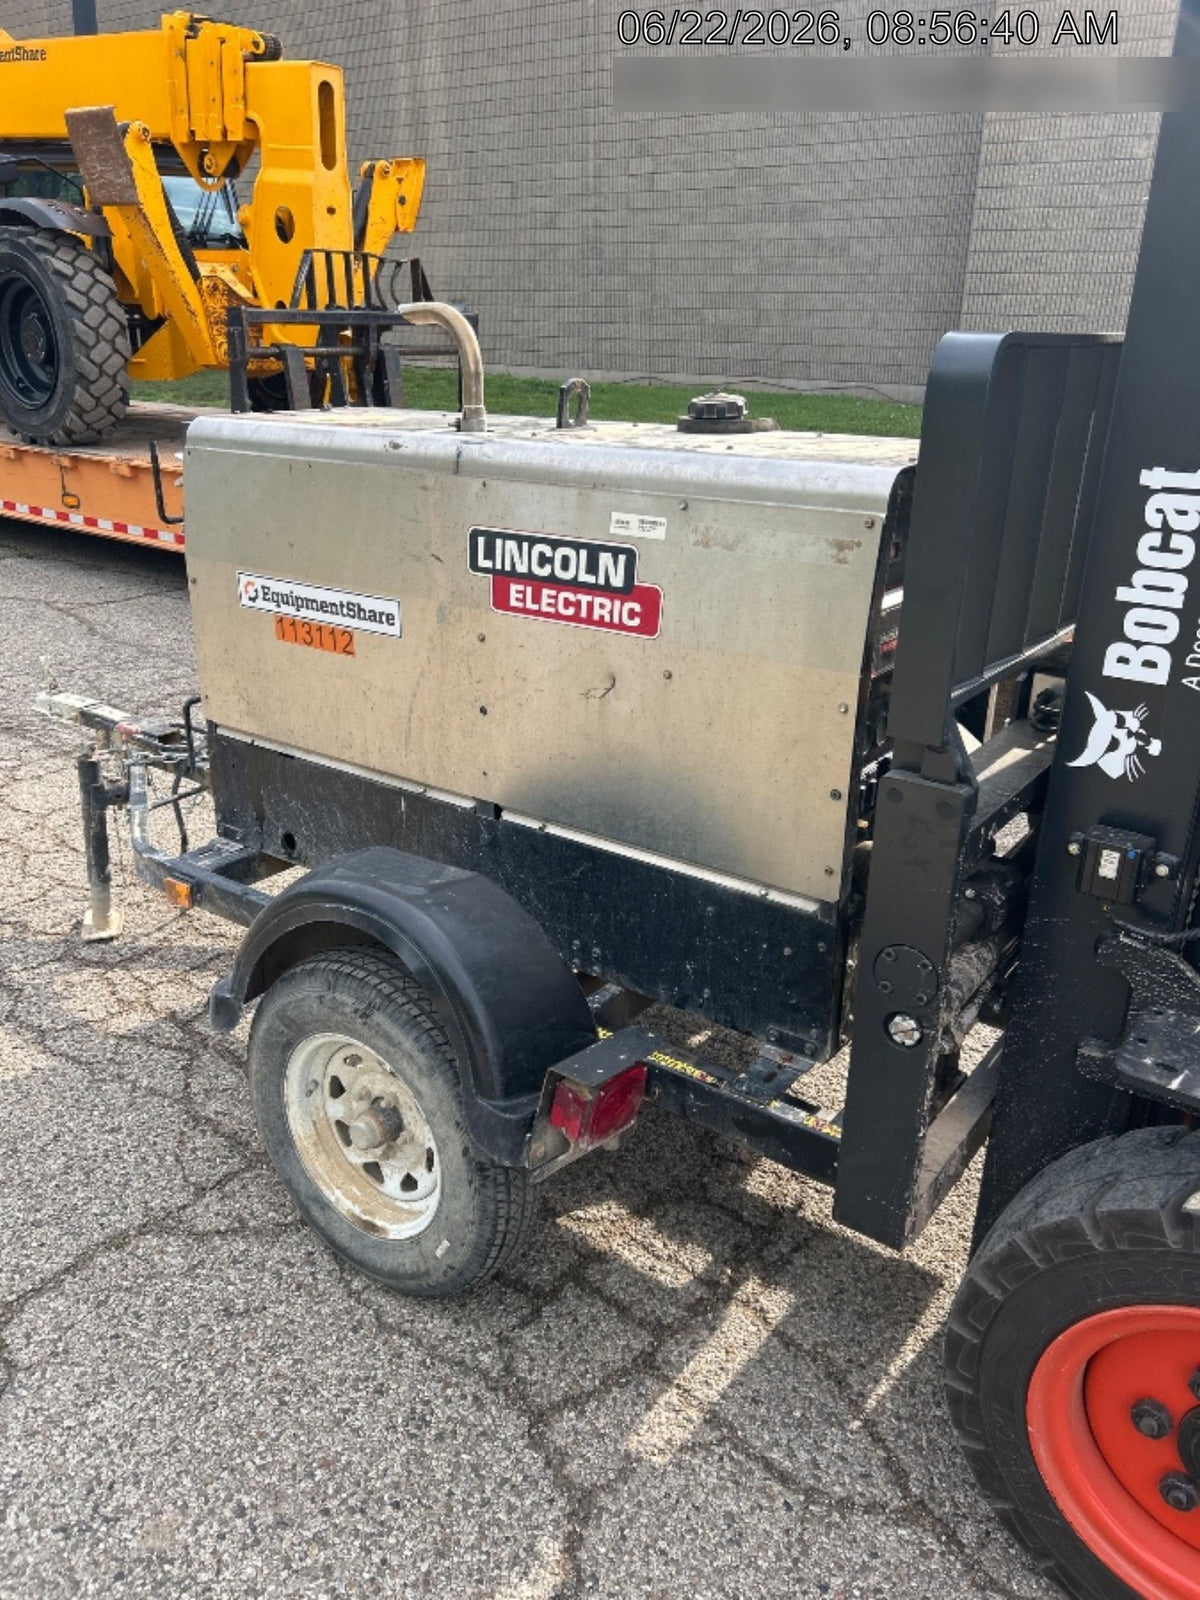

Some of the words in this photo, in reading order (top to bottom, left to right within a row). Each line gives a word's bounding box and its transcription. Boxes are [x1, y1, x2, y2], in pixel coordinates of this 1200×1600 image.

[477, 536, 627, 588] LINCOLN
[1102, 466, 1200, 686] Bobcat
[260, 585, 395, 627] EquipmentShare
[509, 583, 642, 627] ELECTRIC
[276, 616, 355, 656] 113112
